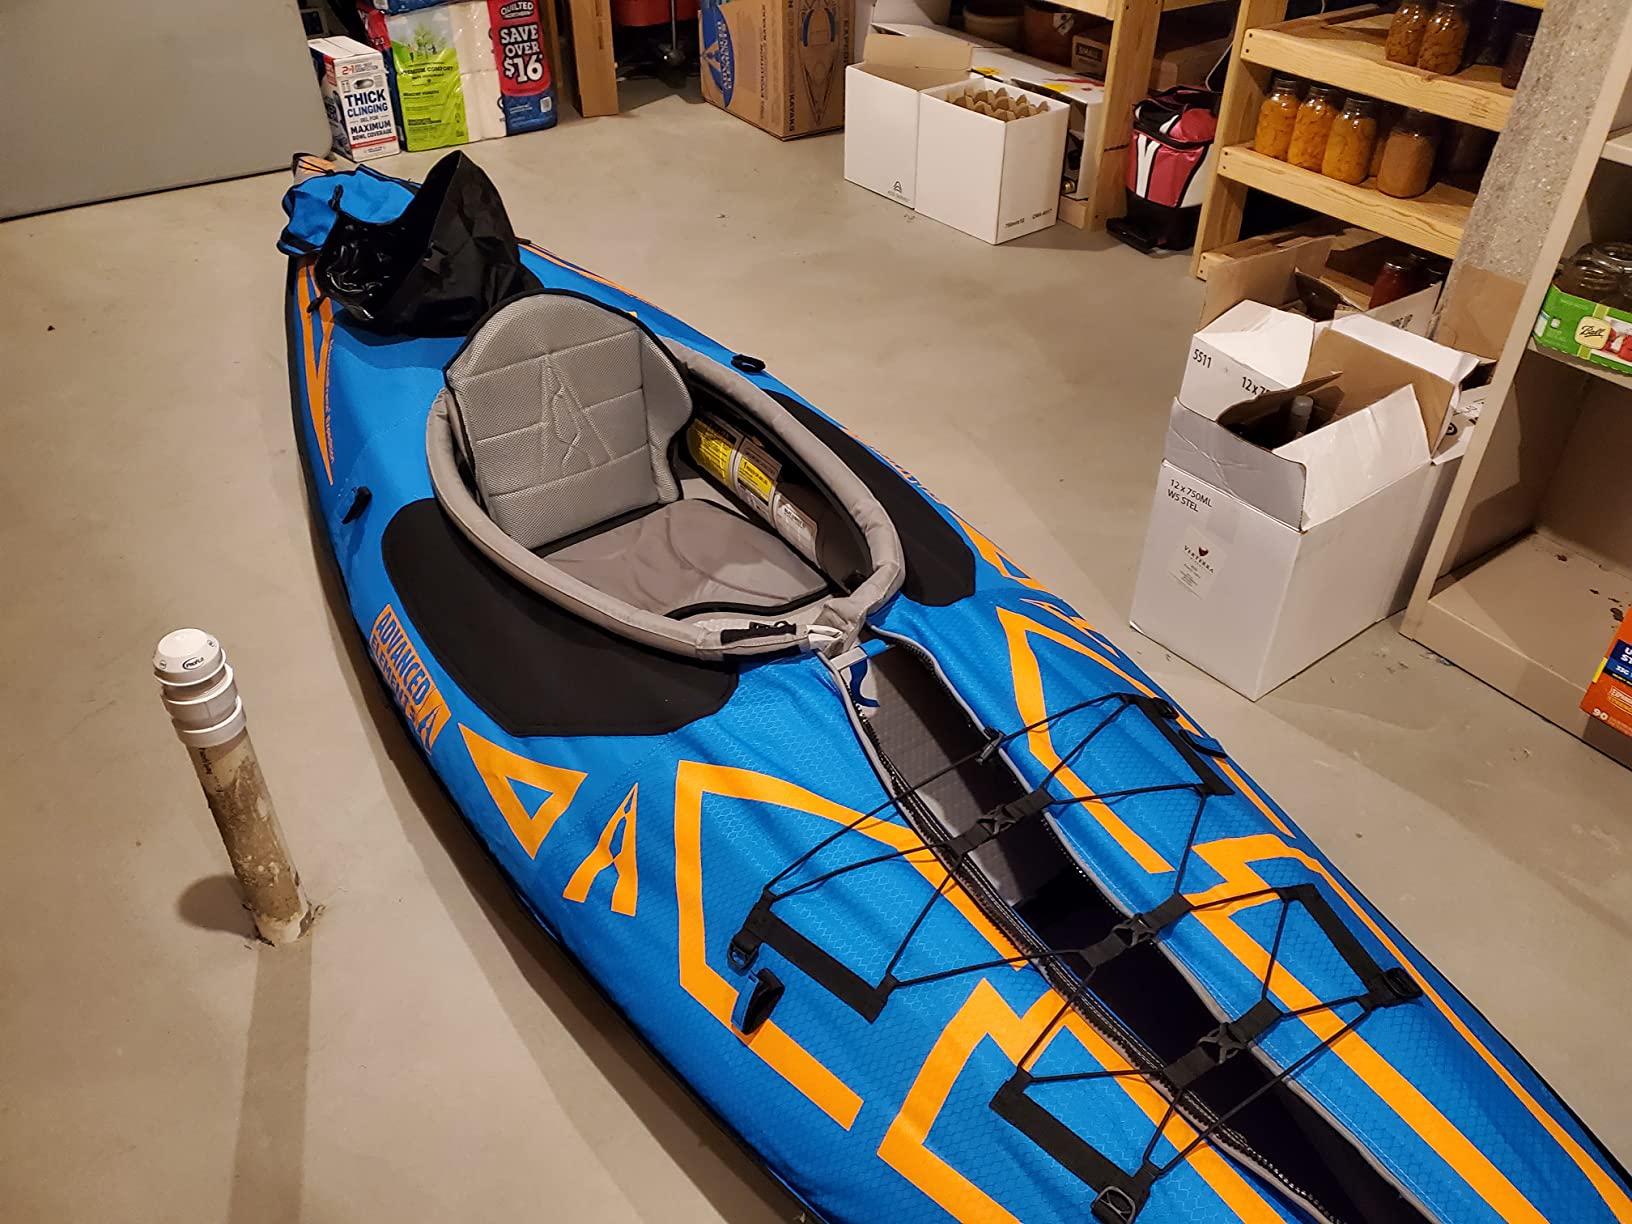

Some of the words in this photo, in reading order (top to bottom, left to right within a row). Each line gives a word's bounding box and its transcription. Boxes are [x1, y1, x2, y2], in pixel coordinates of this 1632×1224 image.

[501, 1, 534, 15] QUILTED
[500, 24, 539, 44] SAVE
[505, 42, 540, 57] OVER
[344, 89, 386, 107] THICK
[347, 103, 388, 118] CLINGING
[351, 120, 391, 134] MAXIMUM
[367, 129, 392, 138] COVERAGE
[1579, 325, 1605, 338] Ball
[1192, 348, 1212, 368] 5511
[1170, 479, 1179, 490] 12
[1186, 487, 1212, 508] 750ML
[1180, 496, 1198, 512] STEL
[376, 611, 431, 705] ADVANCED
[1593, 708, 1609, 721] 90
